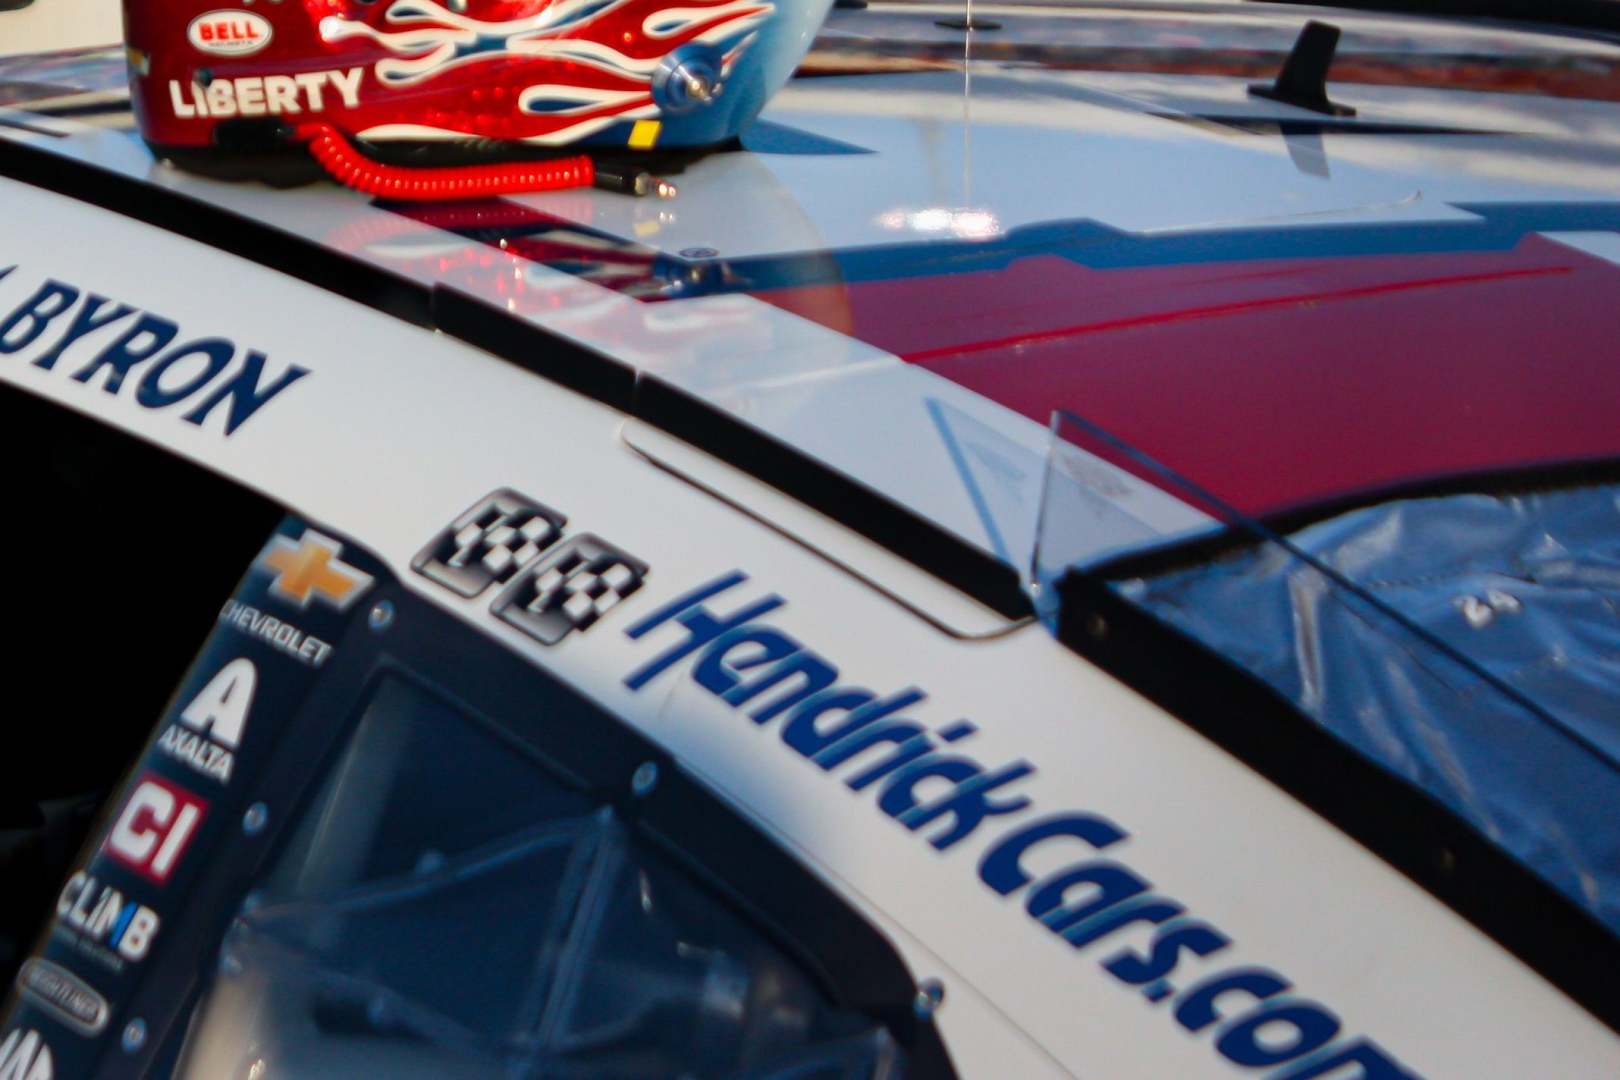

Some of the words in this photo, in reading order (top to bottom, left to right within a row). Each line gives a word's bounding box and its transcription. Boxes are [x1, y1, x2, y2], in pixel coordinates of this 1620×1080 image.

[198, 20, 259, 42] BELL
[169, 66, 364, 117] LIBERTY
[219, 598, 334, 667] CHEVROLET
[158, 723, 235, 784] AXALTA
[109, 781, 200, 877] CI
